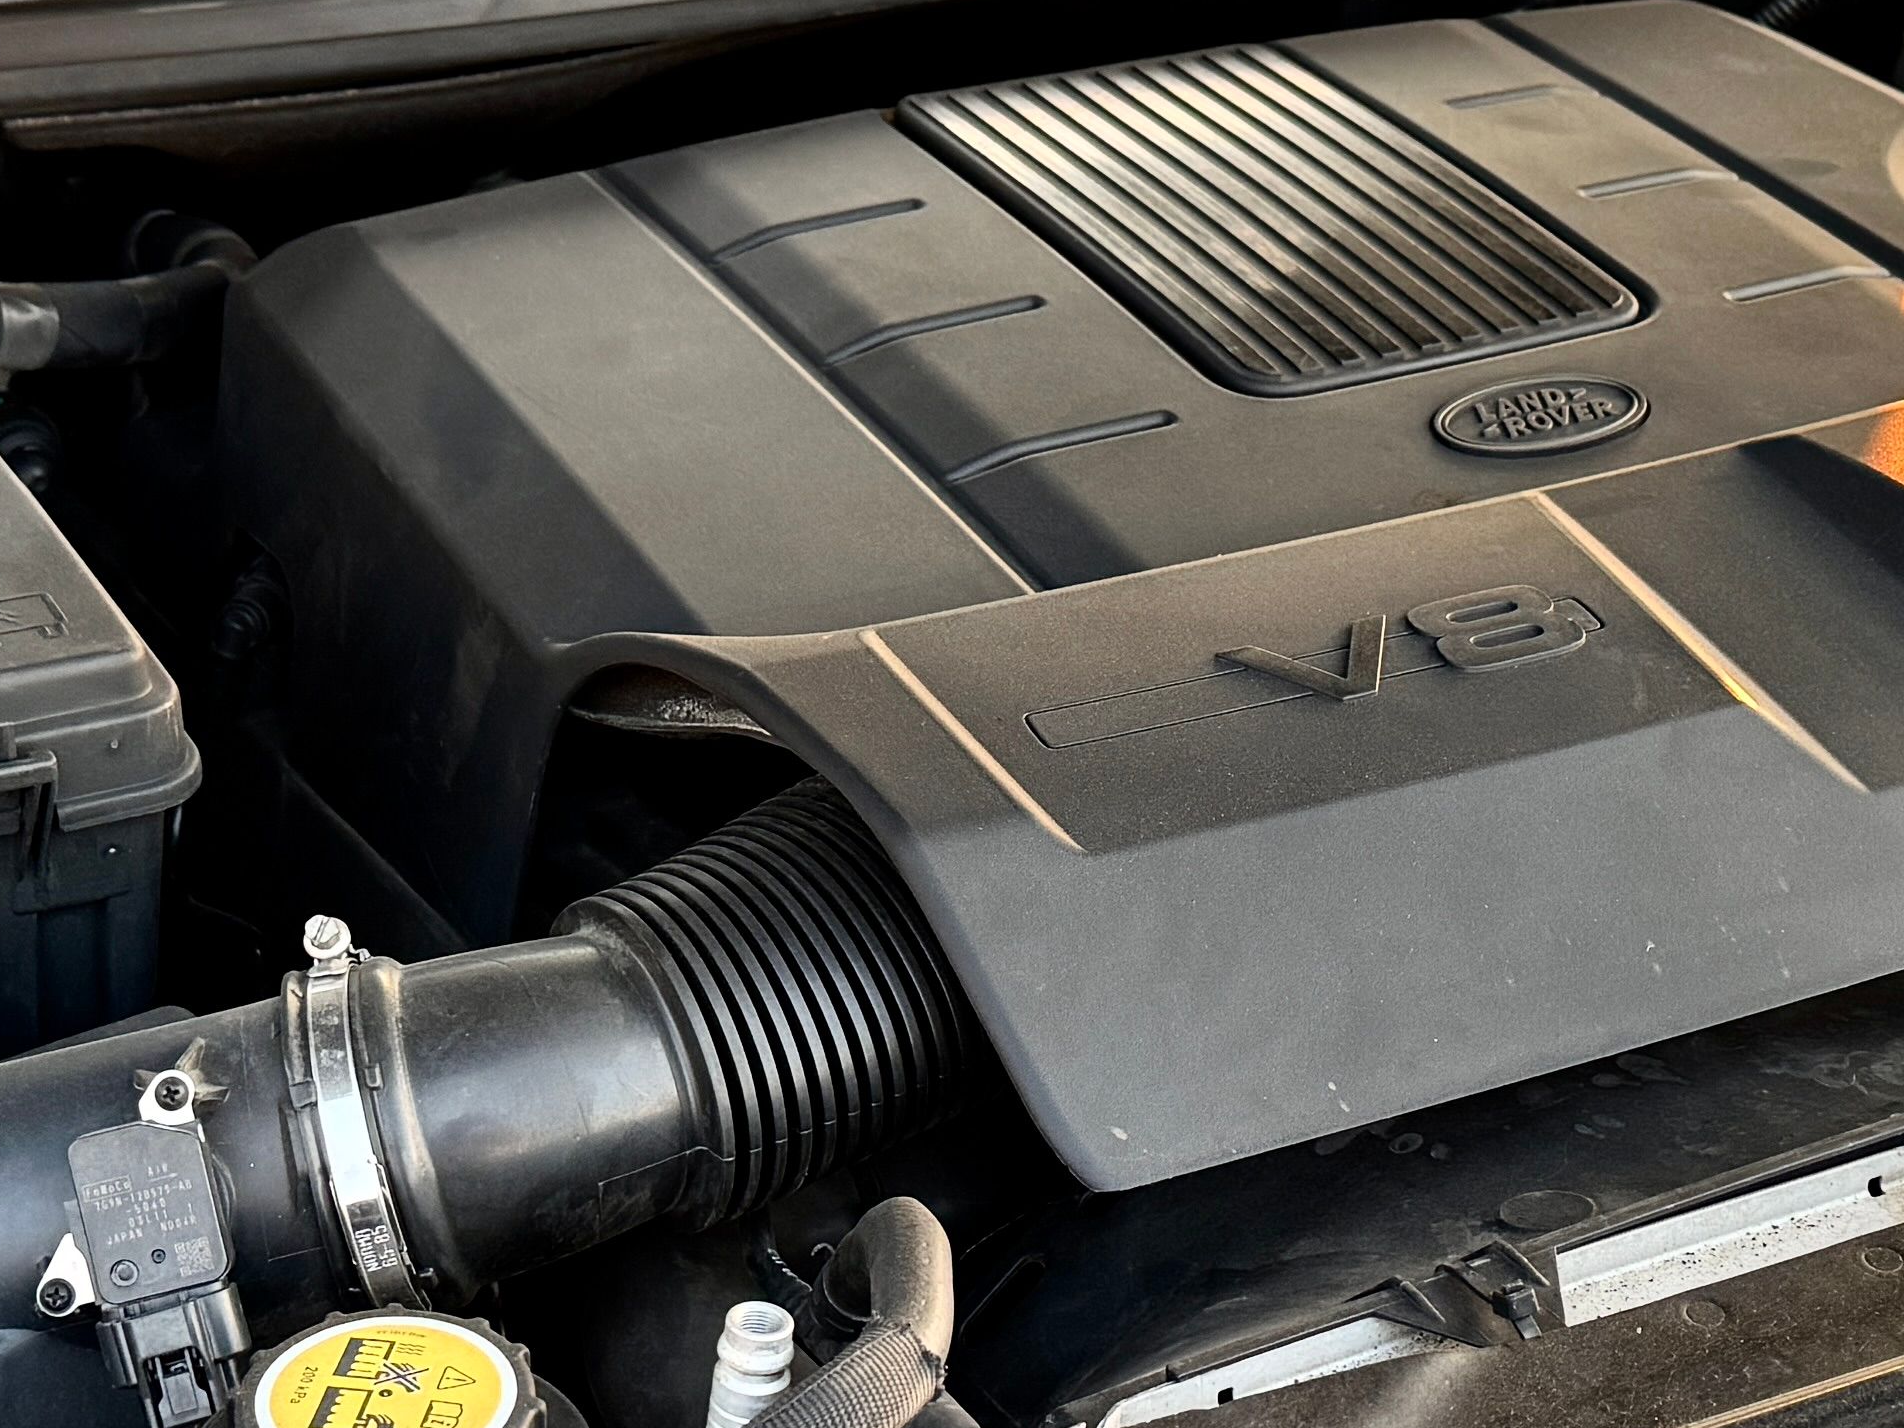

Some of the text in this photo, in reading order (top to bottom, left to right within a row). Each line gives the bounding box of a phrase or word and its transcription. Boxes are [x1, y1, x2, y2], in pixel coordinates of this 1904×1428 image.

[1475, 387, 1567, 424] LAND
[1502, 397, 1622, 439] ROVER
[1214, 583, 1589, 702] V8
[107, 1228, 143, 1246] JAPAN
[355, 1228, 382, 1272] NORMA
[300, 1366, 319, 1384] 200
